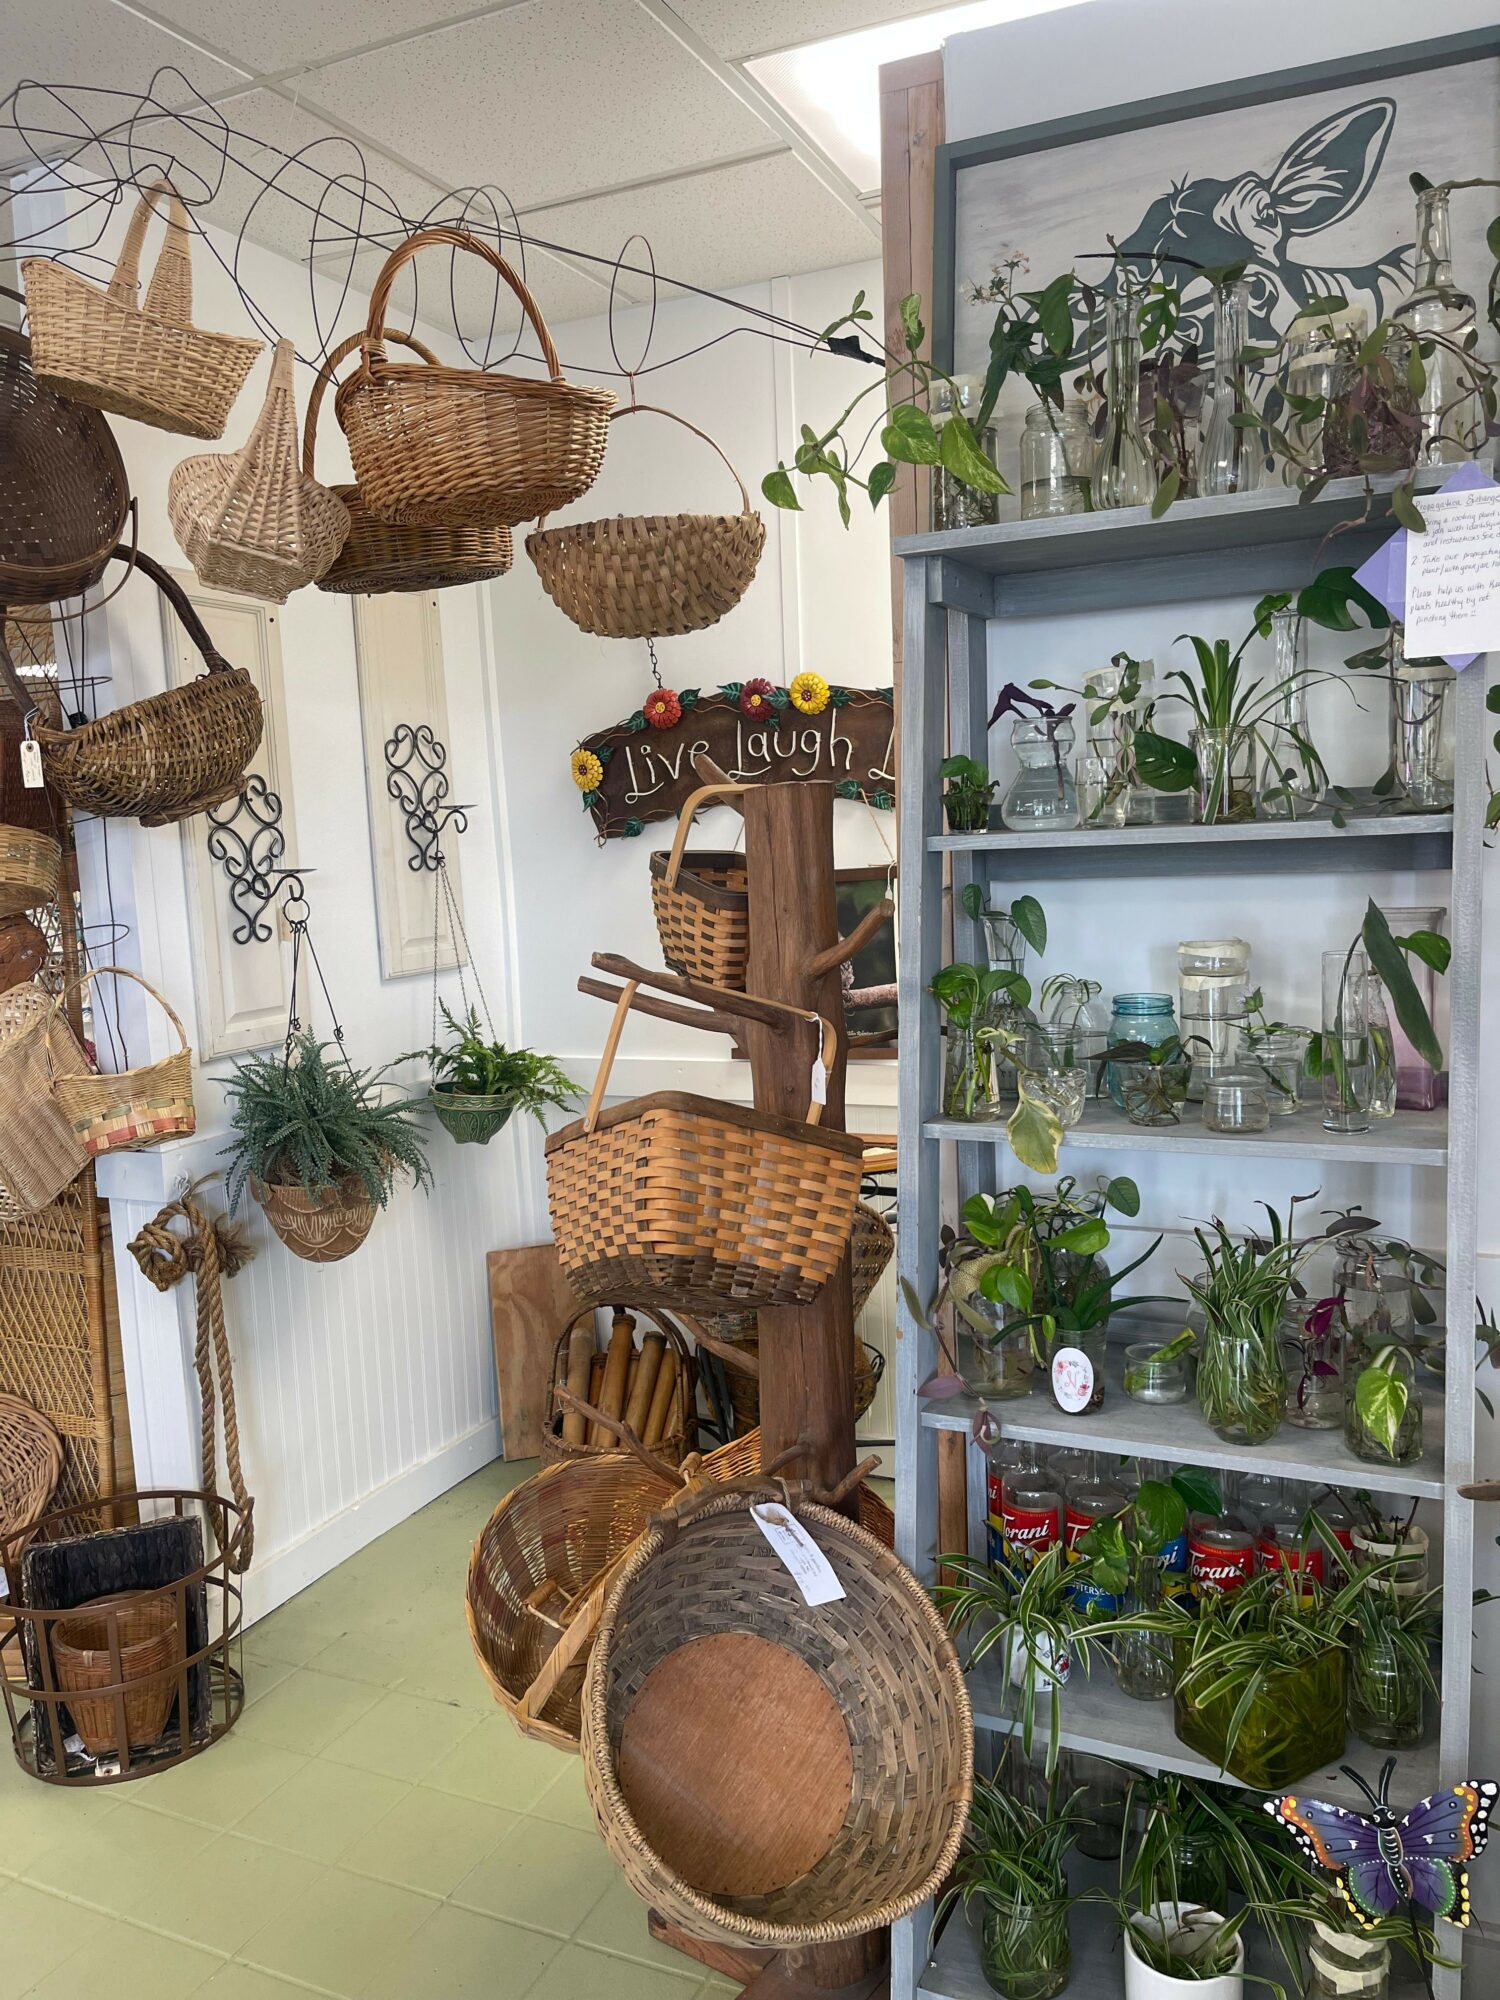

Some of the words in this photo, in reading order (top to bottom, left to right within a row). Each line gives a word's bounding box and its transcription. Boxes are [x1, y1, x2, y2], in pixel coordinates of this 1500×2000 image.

[1415, 499, 1461, 512] Propagation
[1479, 510, 1496, 520] plant
[1448, 525, 1464, 533] with
[1423, 538, 1438, 548] and
[1423, 554, 1441, 565] Take
[1412, 586, 1432, 599] Please
[1437, 584, 1453, 596] help
[1455, 585, 1464, 593] us
[1467, 582, 1485, 592] with
[1410, 601, 1431, 615] plants
[1435, 597, 1464, 610] healthy
[1466, 597, 1476, 607] by
[1478, 592, 1491, 602] not
[1416, 614, 1447, 627] pinching
[625, 740, 709, 804] Live
[727, 708, 853, 780] Laugh
[1002, 1512, 1050, 1540] Torani
[1190, 1549, 1245, 1579] Torani
